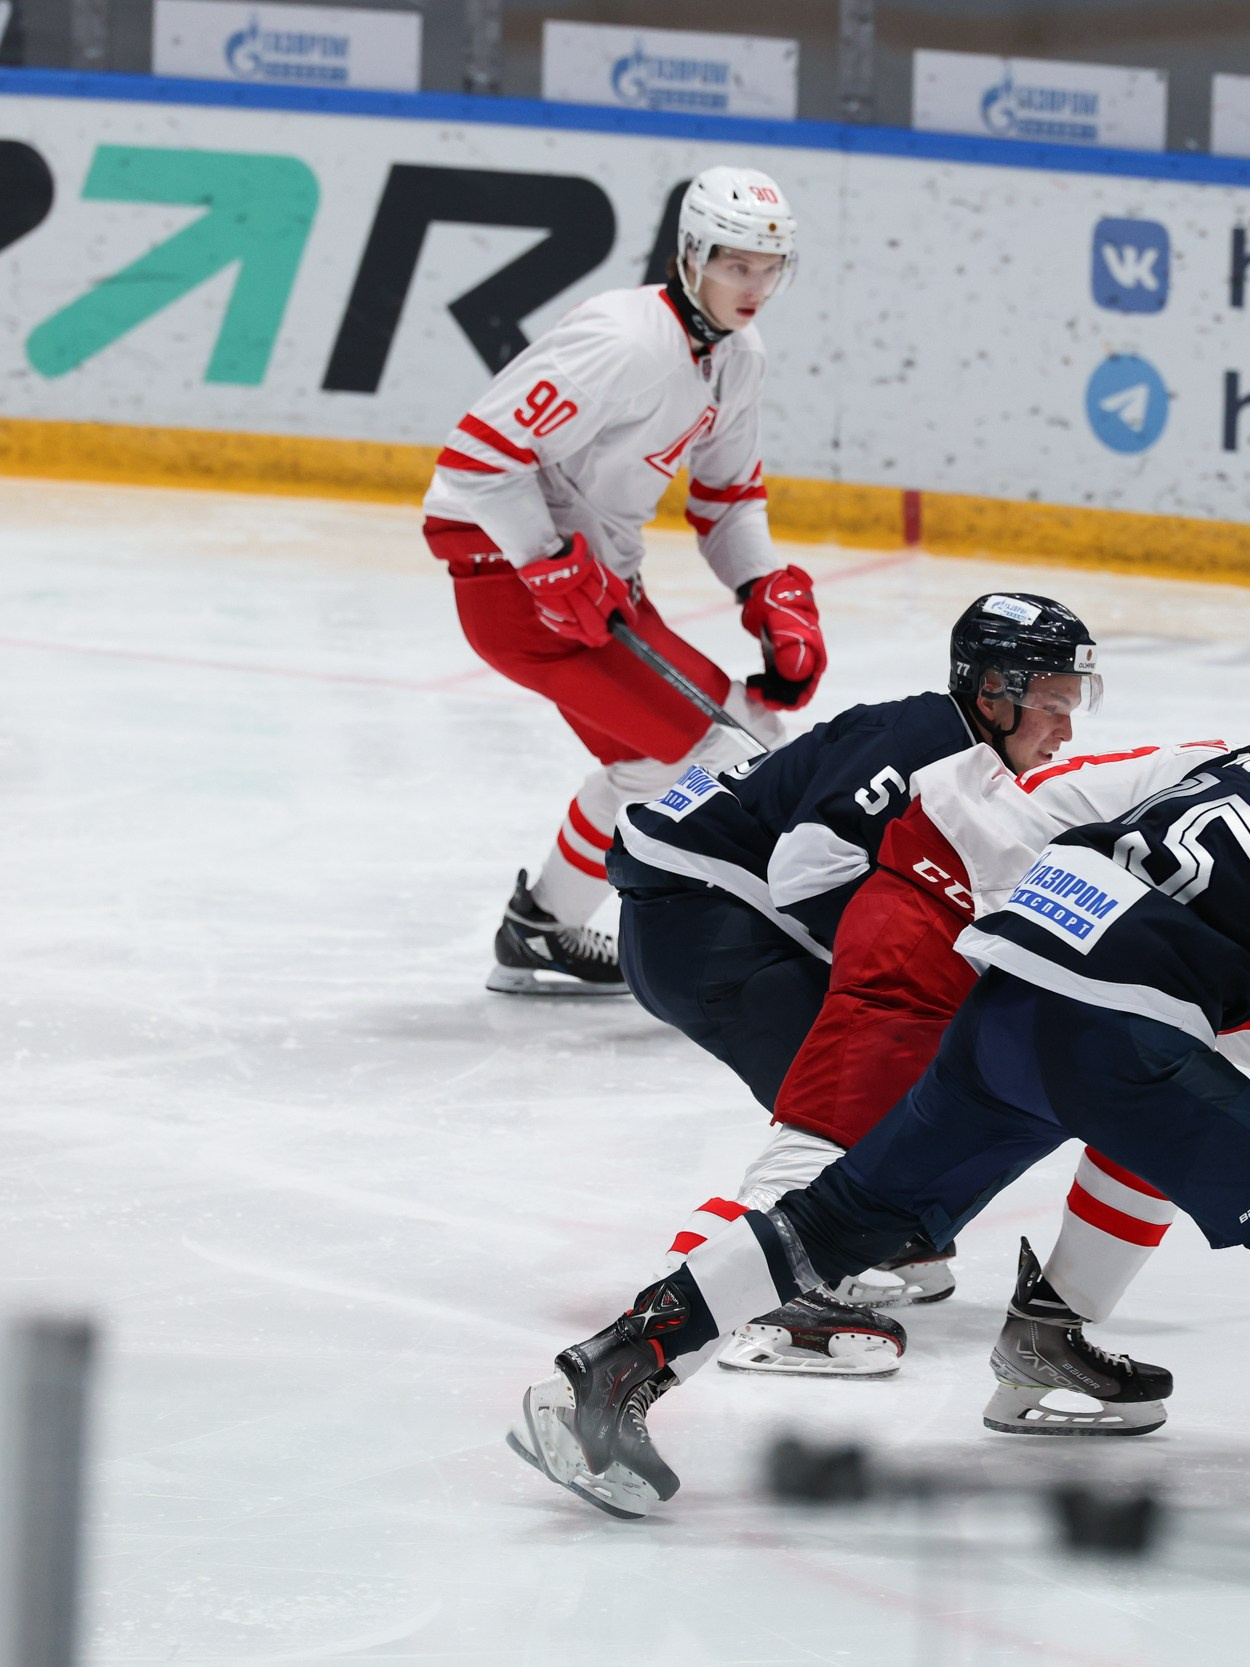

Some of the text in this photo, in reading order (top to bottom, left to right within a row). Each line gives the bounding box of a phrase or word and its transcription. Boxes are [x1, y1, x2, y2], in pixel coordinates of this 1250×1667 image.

[749, 186, 779, 205] 90
[514, 380, 579, 438] 90
[956, 661, 971, 677] 77
[854, 764, 907, 816] 5
[912, 856, 975, 918] CC
[1062, 1362, 1101, 1391] BAUER
